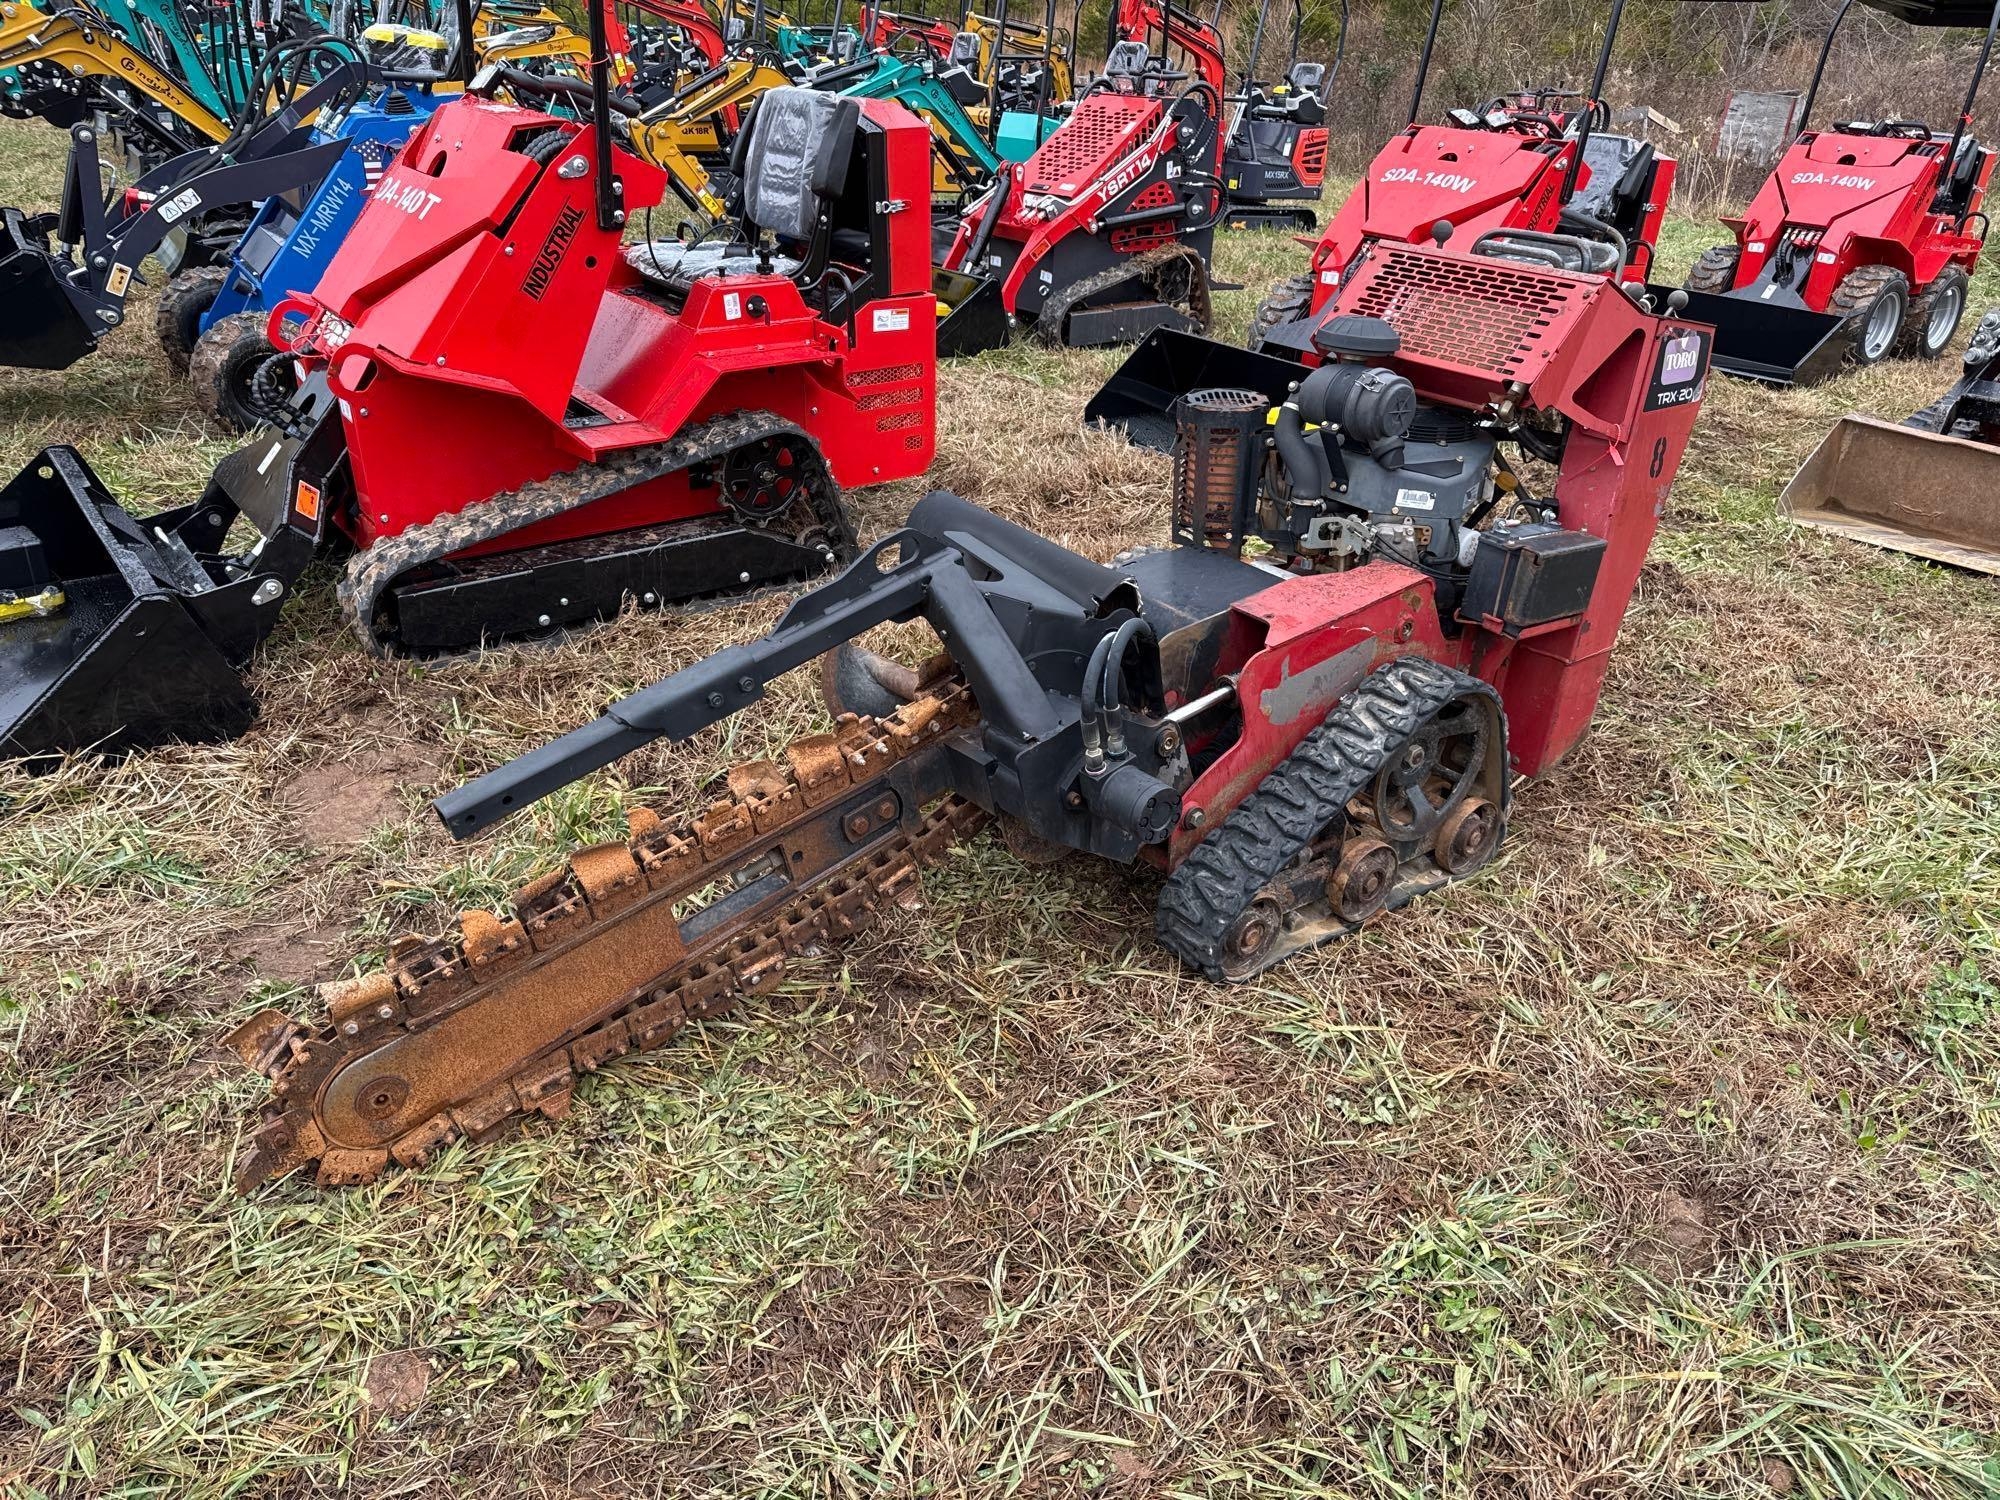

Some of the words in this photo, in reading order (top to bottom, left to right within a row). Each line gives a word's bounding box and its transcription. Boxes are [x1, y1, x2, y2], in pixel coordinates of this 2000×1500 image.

[372, 176, 443, 222] DA-140T
[1096, 152, 1152, 203] YSRT14
[1380, 167, 1478, 194] SDA-140W
[1790, 172, 1877, 191] SDA-140W
[291, 177, 354, 260] MX-MRW14
[1526, 184, 1555, 231] DUSTRIAL
[522, 204, 585, 301] INDUSTRIAL
[1666, 350, 1697, 371] TORO
[1649, 436, 1667, 479] 8
